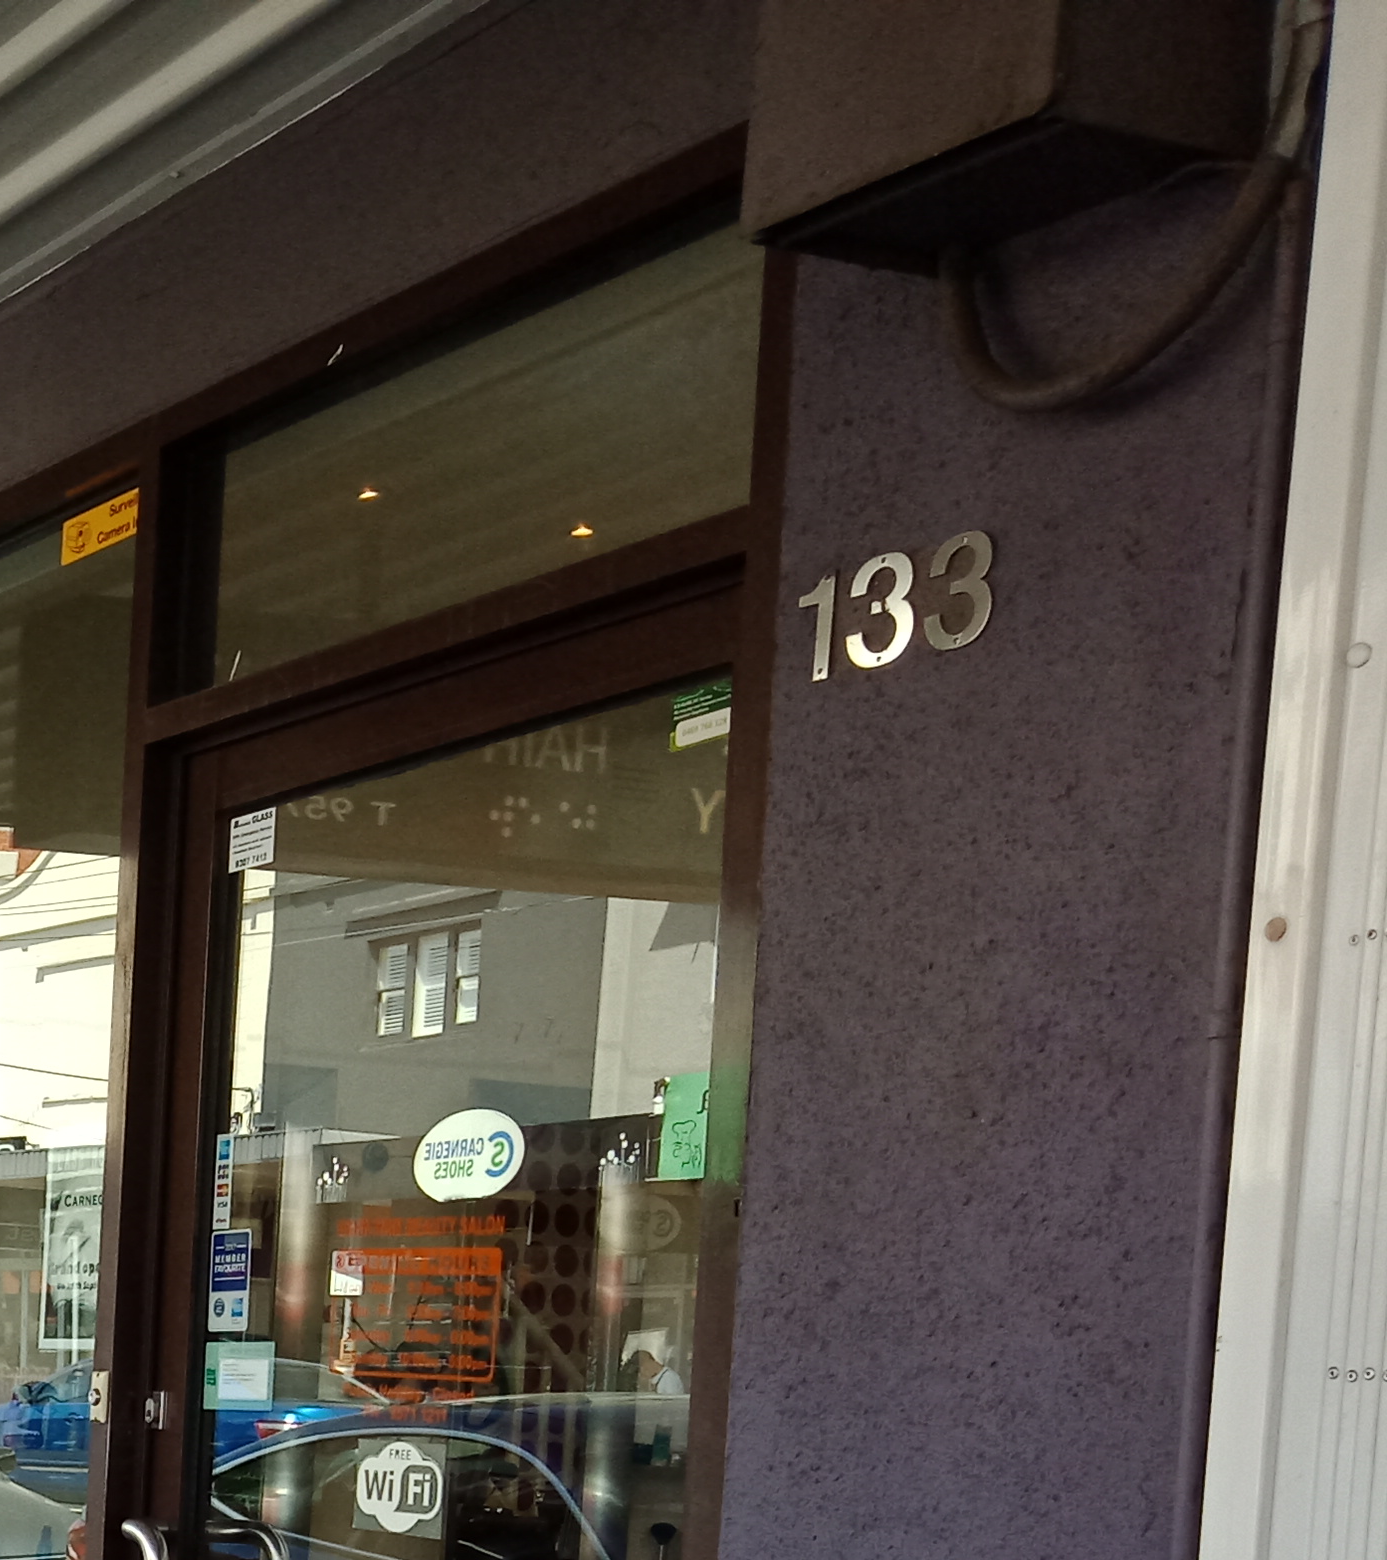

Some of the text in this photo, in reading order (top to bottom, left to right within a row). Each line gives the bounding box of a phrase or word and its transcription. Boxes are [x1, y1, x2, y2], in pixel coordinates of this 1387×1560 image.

[97, 522, 131, 545] Camera
[797, 530, 994, 683] 133
[388, 1448, 412, 1461] FREE
